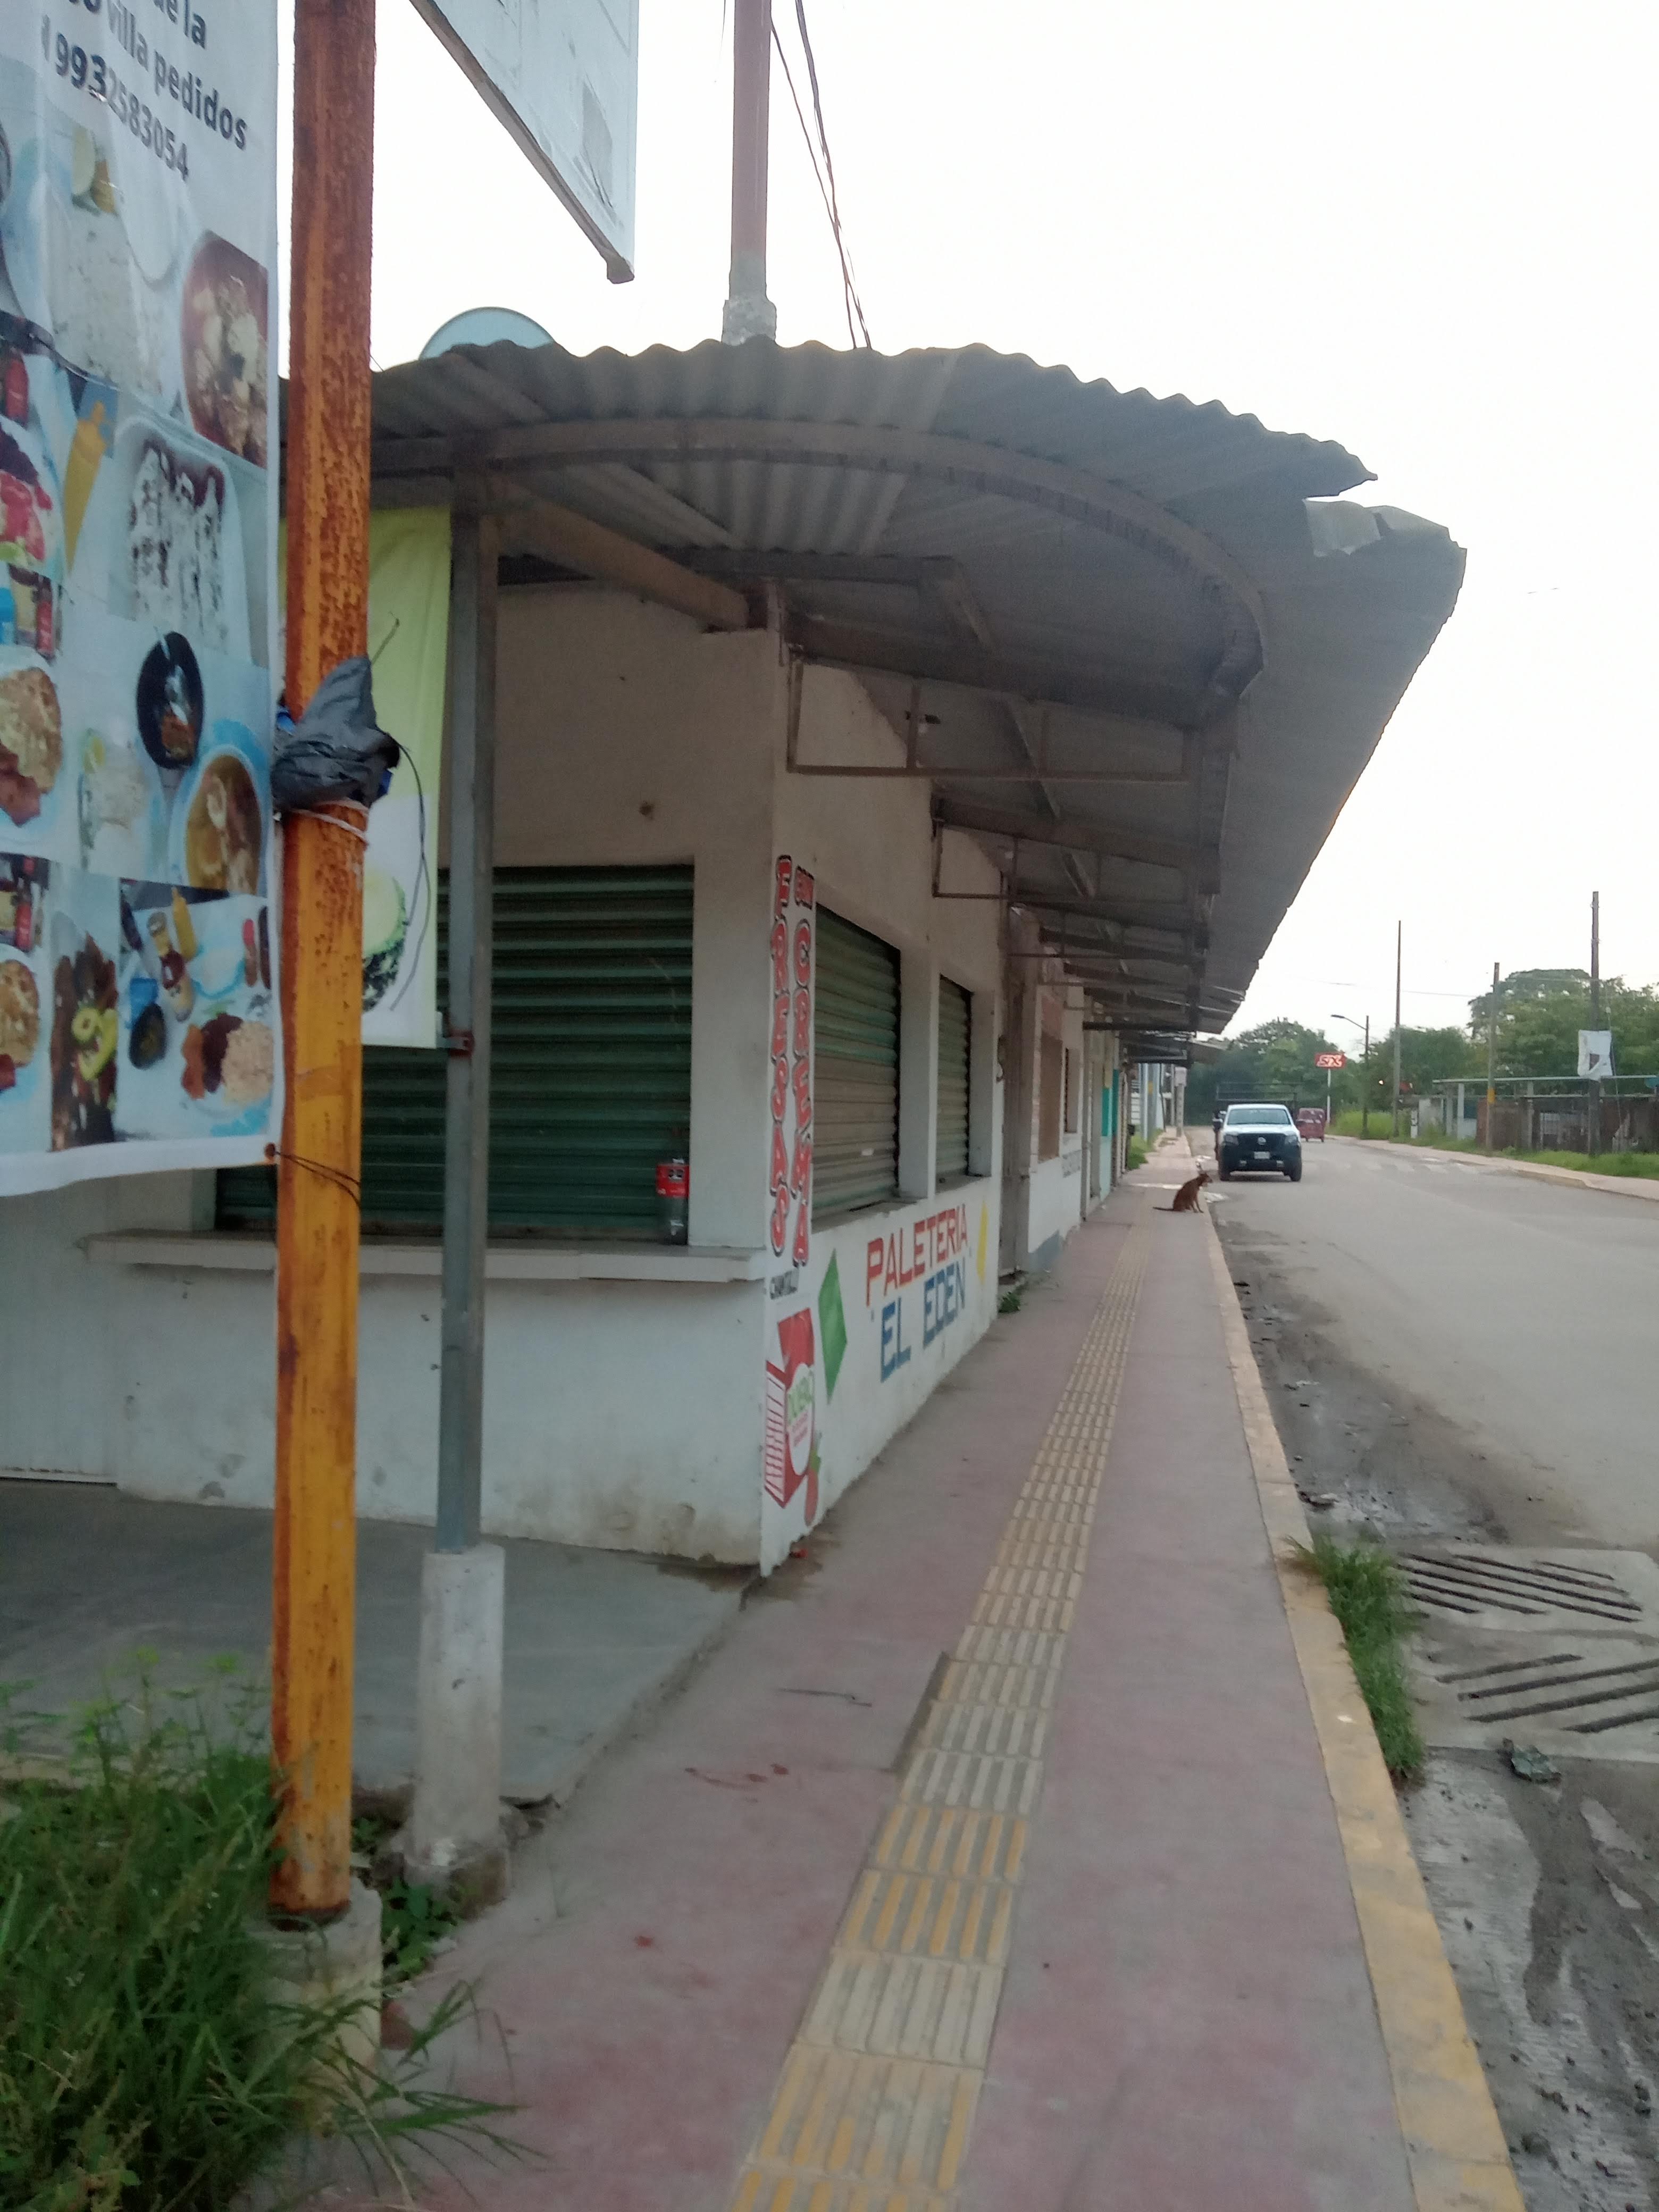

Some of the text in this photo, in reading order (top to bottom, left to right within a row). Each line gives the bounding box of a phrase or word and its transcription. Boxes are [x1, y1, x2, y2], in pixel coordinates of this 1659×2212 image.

[154, 49, 248, 151] pedidos
[866, 1203, 968, 1308] PALETERIA
[880, 1256, 966, 1384] EL EDEN
